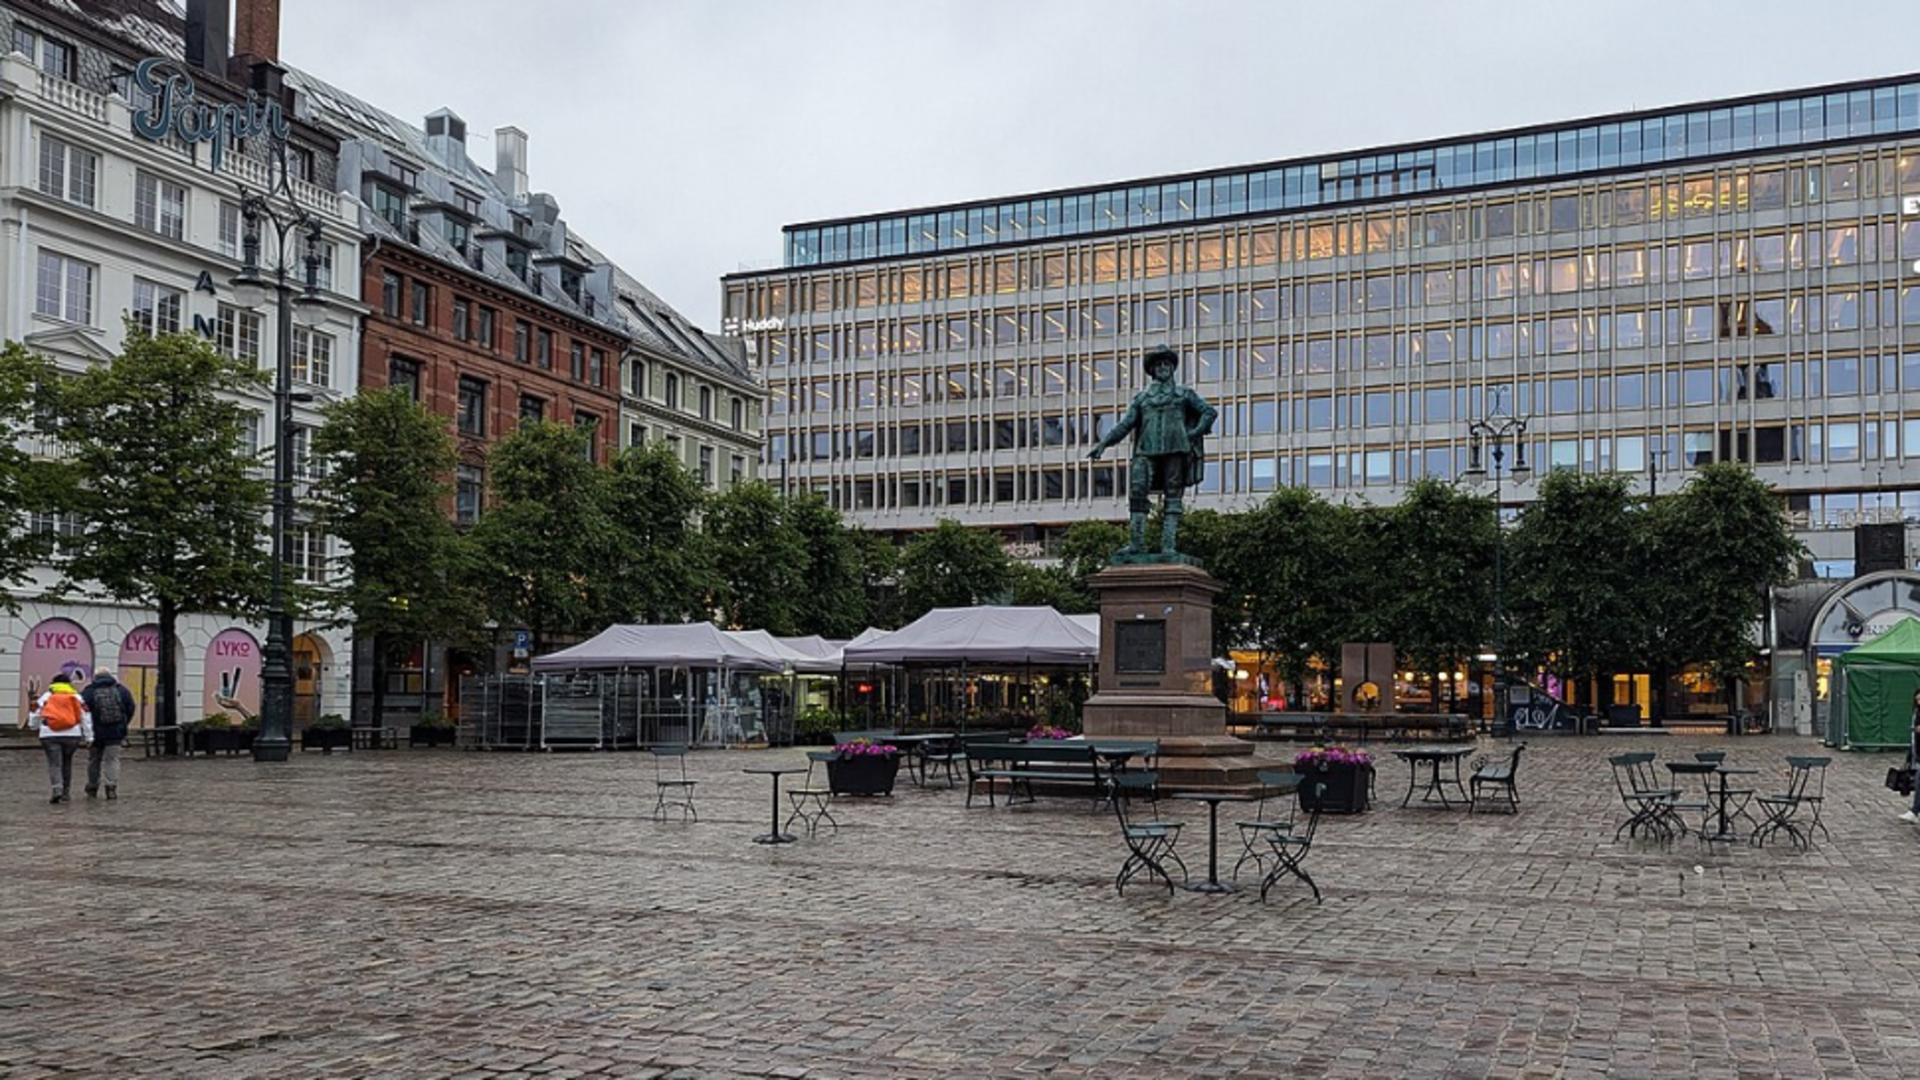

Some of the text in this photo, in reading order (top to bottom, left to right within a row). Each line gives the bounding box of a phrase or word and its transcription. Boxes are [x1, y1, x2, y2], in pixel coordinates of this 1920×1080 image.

[134, 57, 290, 170] Papir
[742, 316, 785, 332] Huddly
[35, 632, 79, 650] LYKO
[216, 641, 251, 657] LYKO
